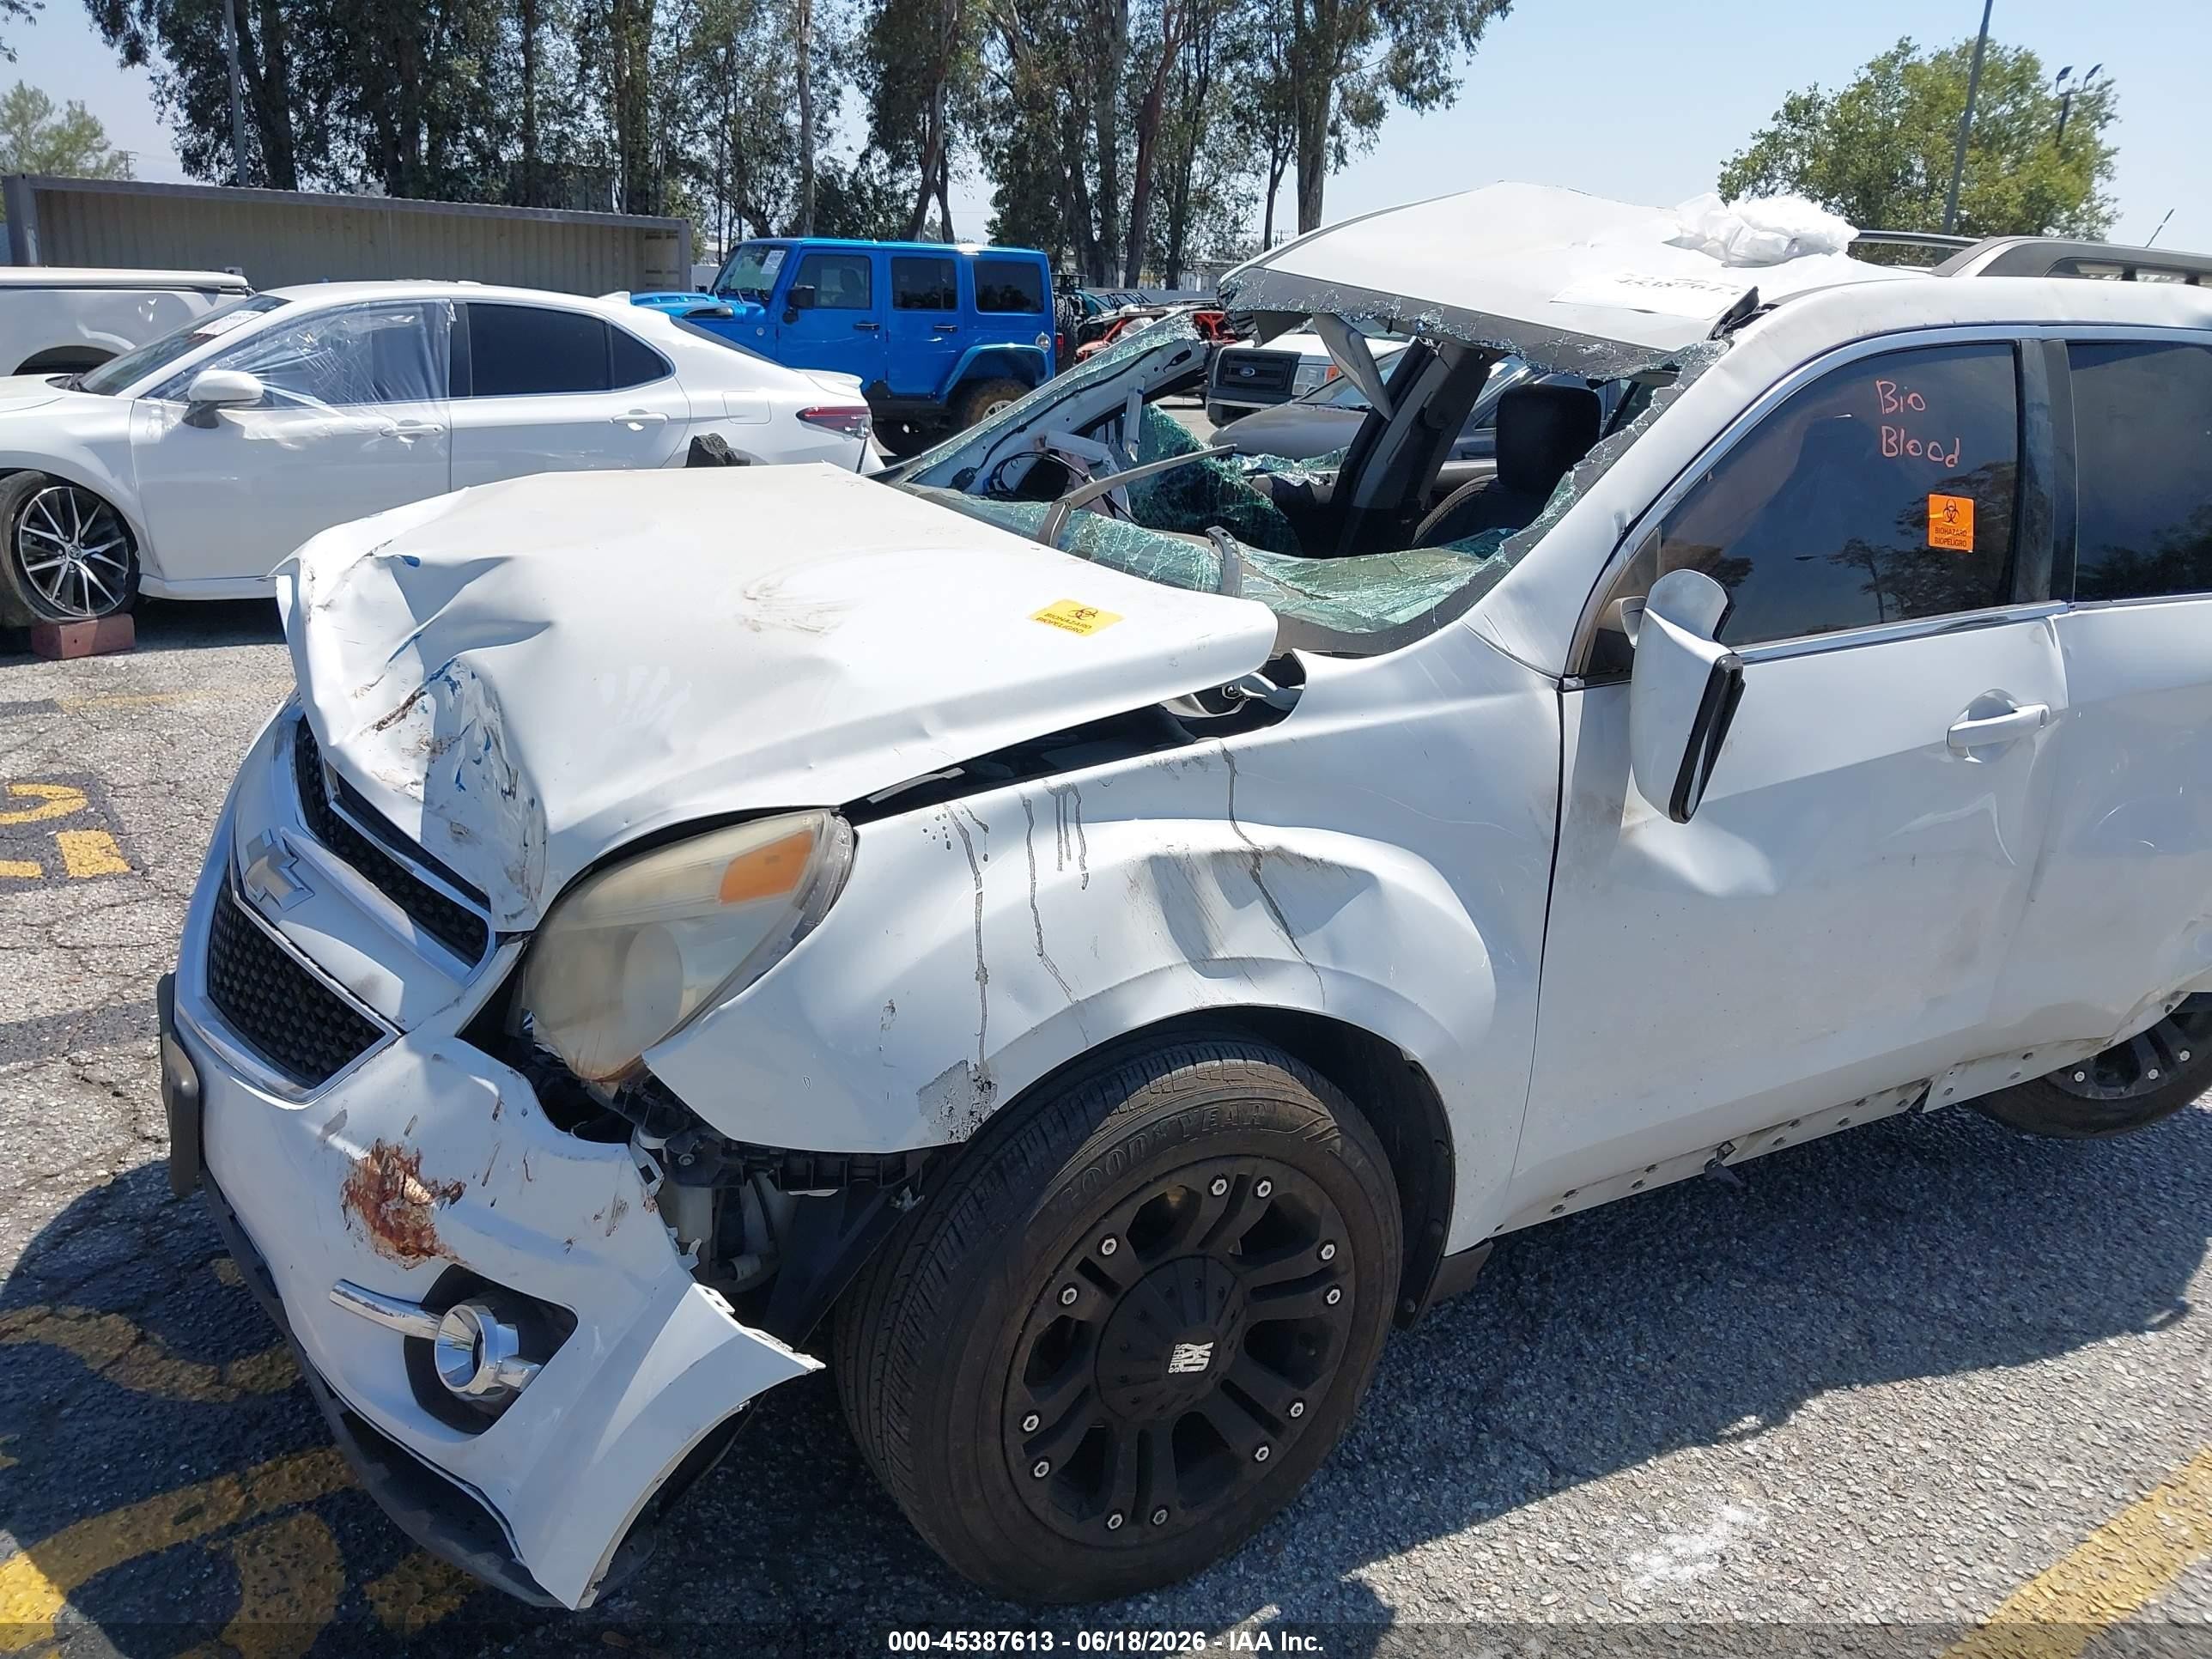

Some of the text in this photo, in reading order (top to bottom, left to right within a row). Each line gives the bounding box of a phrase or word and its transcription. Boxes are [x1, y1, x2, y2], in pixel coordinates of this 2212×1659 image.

[1875, 380, 1926, 415] Bio
[1881, 425, 1960, 468] Blood
[1934, 536, 1967, 548] BIOPELIGRO
[1935, 526, 1968, 538] BIOHAZARD
